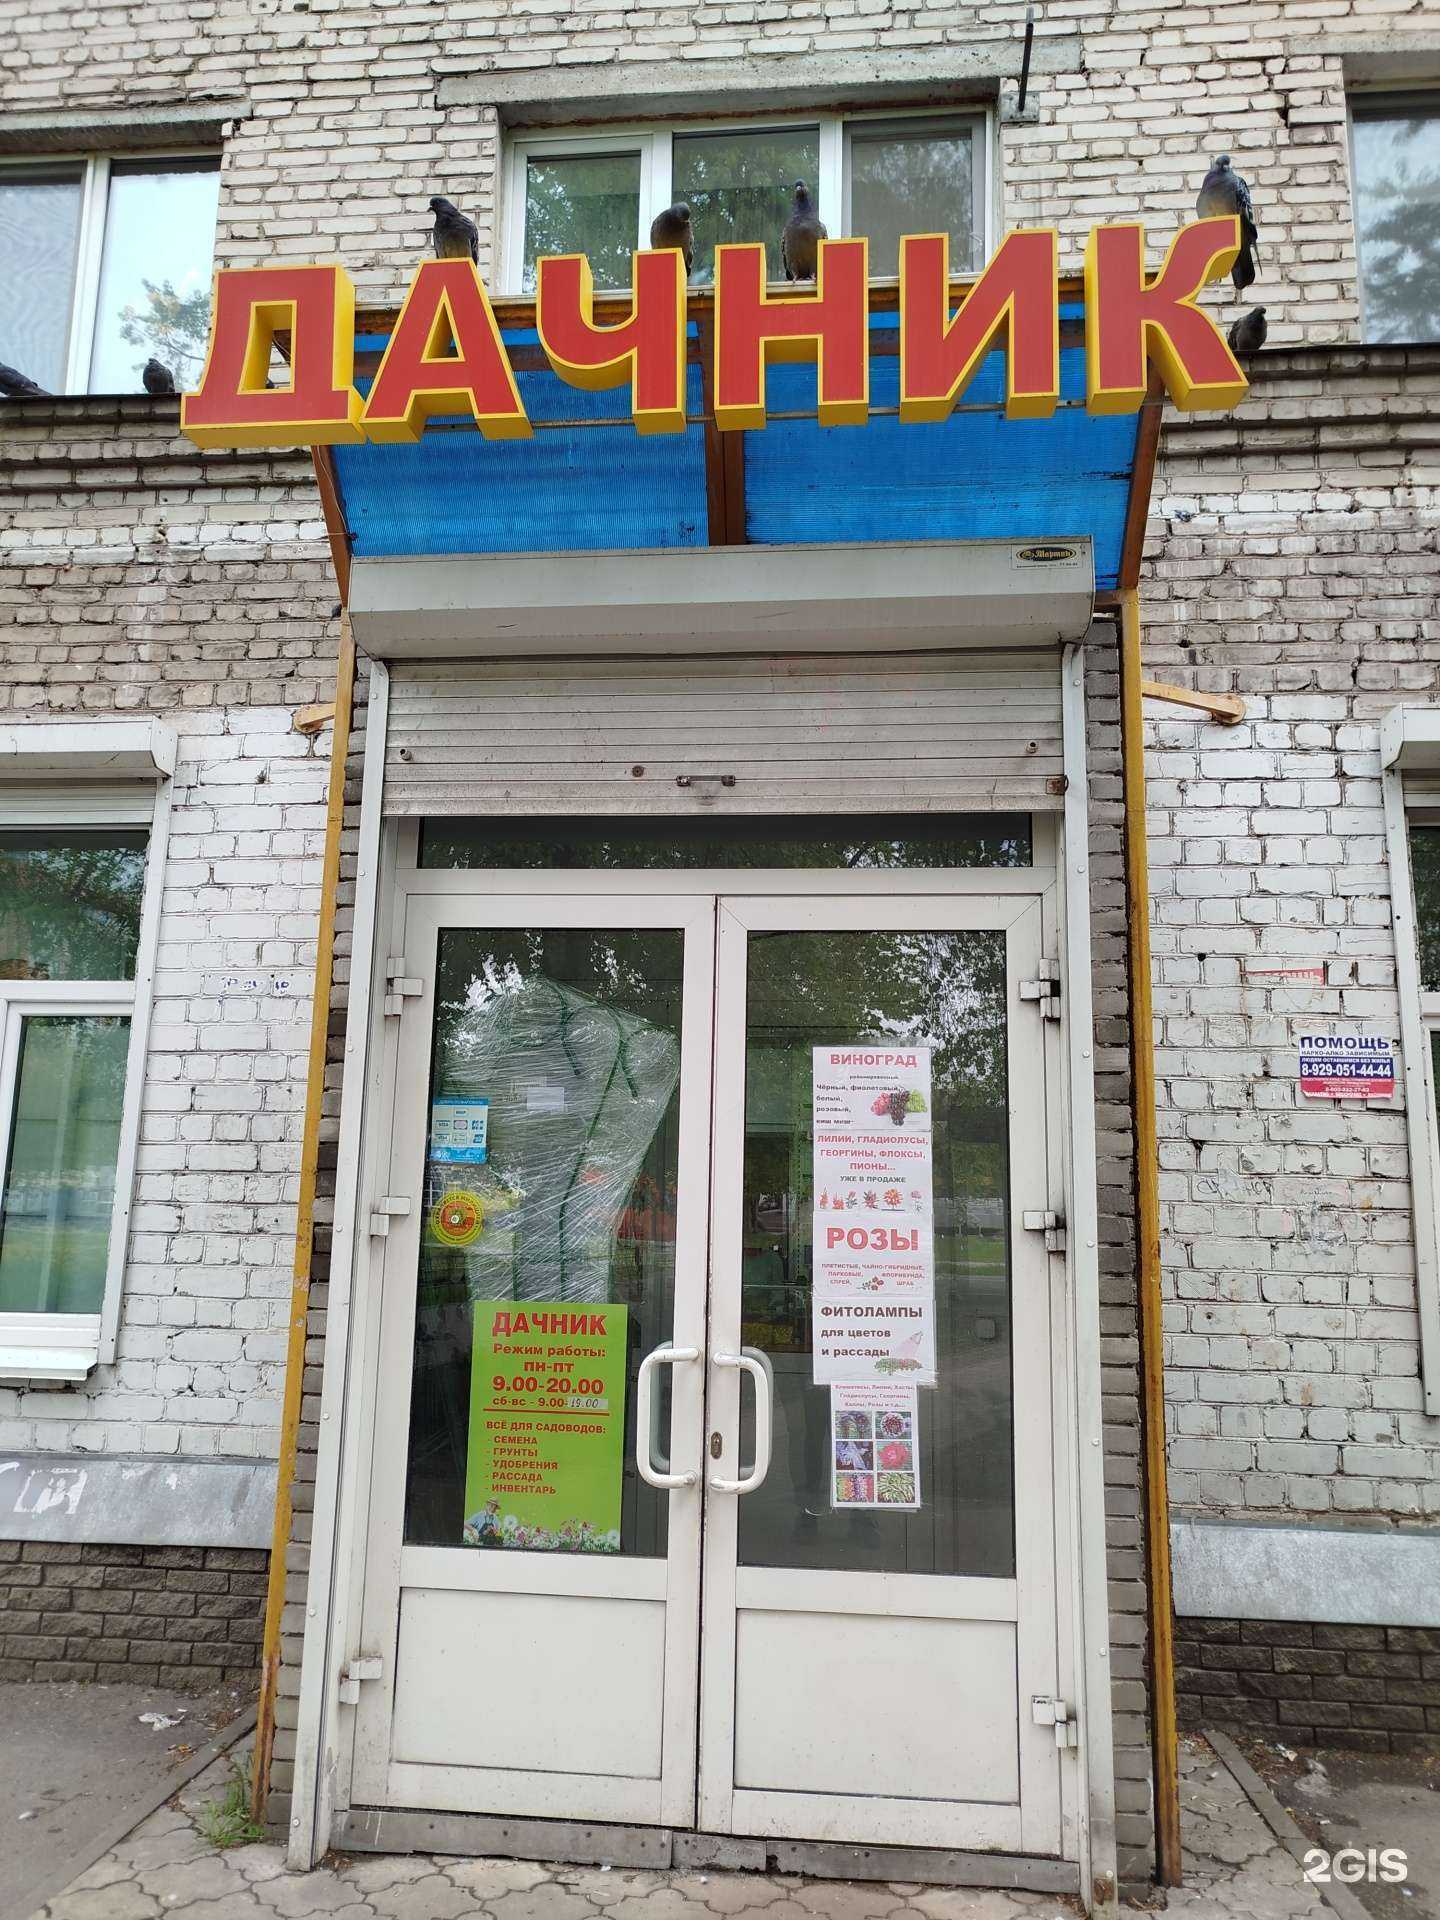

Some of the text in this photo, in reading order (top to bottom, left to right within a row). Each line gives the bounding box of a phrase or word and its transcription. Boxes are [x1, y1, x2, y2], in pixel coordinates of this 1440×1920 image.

[181, 214, 1249, 449] ДАЧНИК
[1300, 1036, 1389, 1051] ПОМОЩЬ
[830, 1054, 918, 1068] ВИНОГРАД
[1301, 1063, 1391, 1077] 8-929-051-44-44
[817, 1135, 929, 1145] ЛИЛИИ, ГЛАДИОЛУСЫ,
[820, 1149, 926, 1159] ГЕОРГИНЫ, ФЛОКСЫ,
[826, 1227, 919, 1251] РОЗЫ
[820, 1306, 923, 1318] ФИТОЛАМПЫ
[492, 1311, 607, 1338] ДАЧНИК
[820, 1329, 891, 1338] для цветов
[493, 1343, 606, 1358] Режим работы:
[821, 1348, 890, 1358] и рассады
[492, 1375, 604, 1395] 9.00-20.00
[486, 1420, 606, 1434] ВСЁ ДЛЯ САДОВОДОВ:
[493, 1436, 538, 1445] СЕМЕНА
[493, 1447, 538, 1457] ГРУНТЫ
[492, 1460, 558, 1470] УДОБРЕНИЯ
[492, 1472, 543, 1482] РАССАДА
[491, 1484, 557, 1495] ИНВЕНТАРЬ
